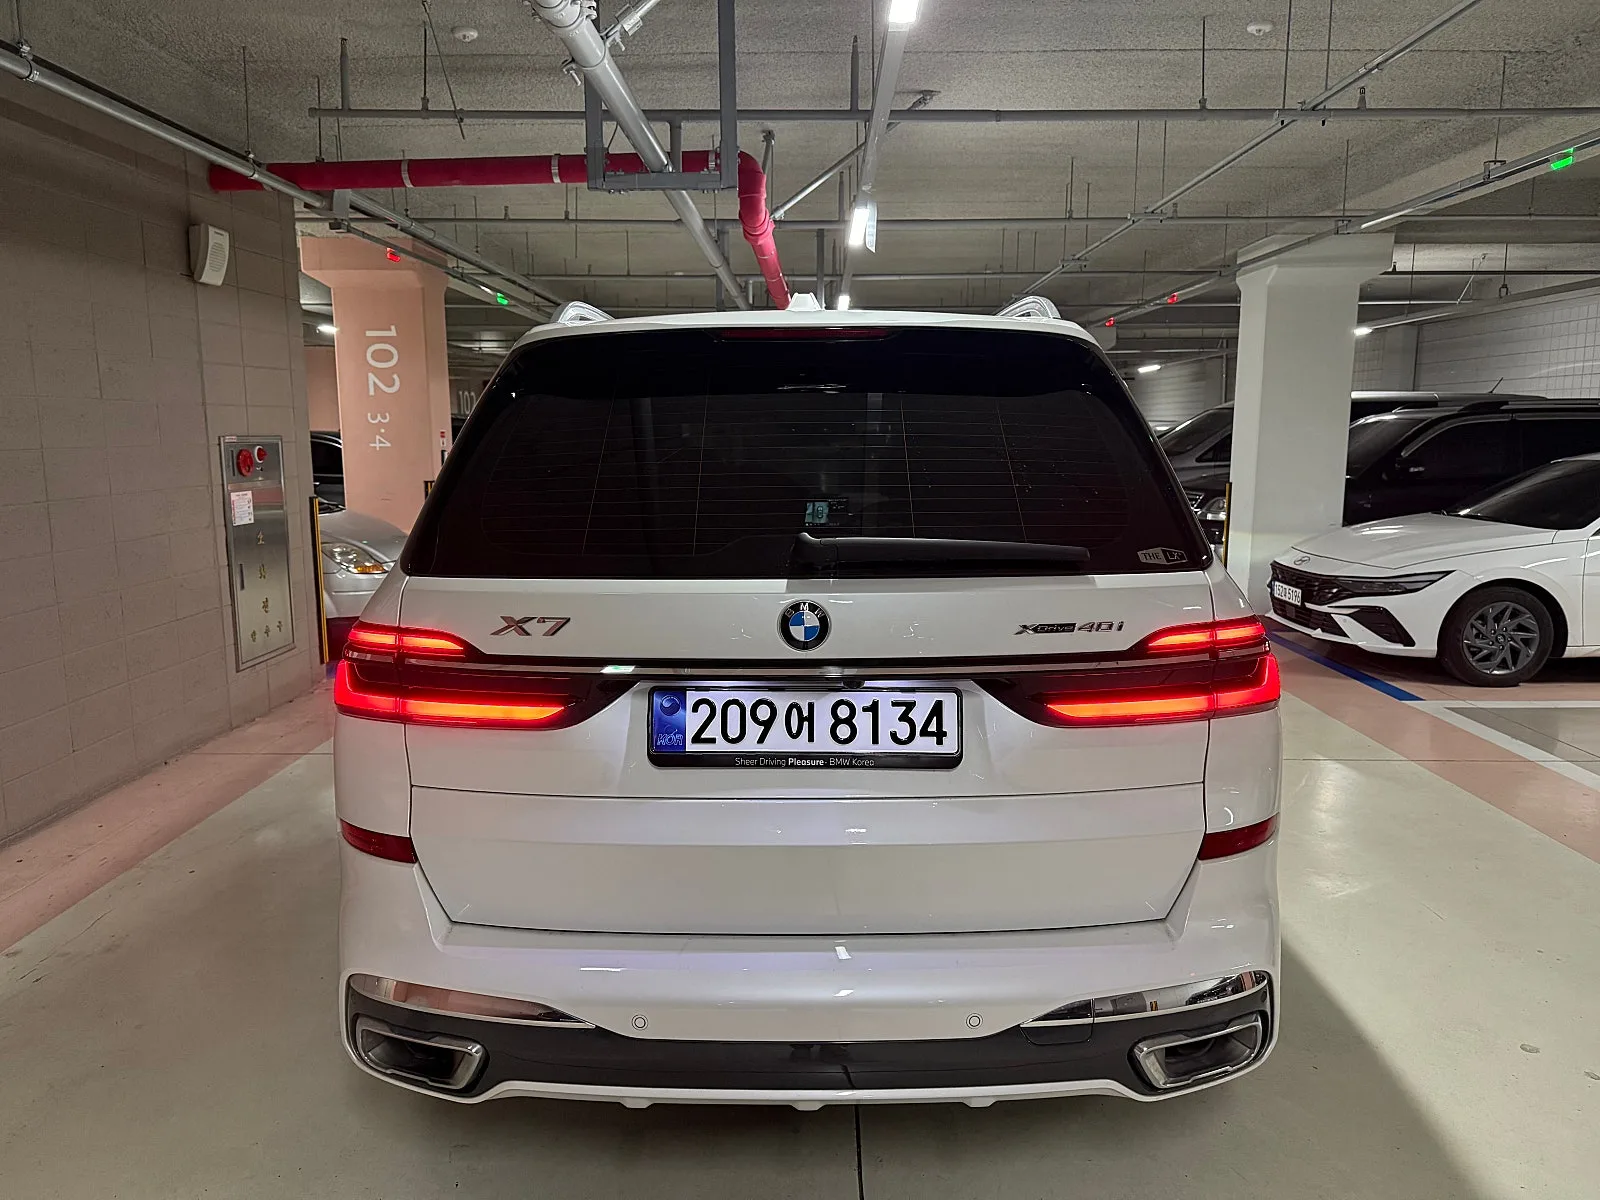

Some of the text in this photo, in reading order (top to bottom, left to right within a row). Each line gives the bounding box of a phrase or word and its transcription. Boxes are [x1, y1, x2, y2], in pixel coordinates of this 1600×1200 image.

[365, 325, 400, 396] 102
[784, 602, 826, 619] BMW
[490, 615, 571, 637] X7
[690, 697, 948, 746] 209어 8134
[656, 733, 684, 746] KOR
[734, 757, 757, 766] Sheer
[760, 757, 786, 767] Driving
[829, 757, 851, 766] BMW
[852, 757, 875, 767] Korea
